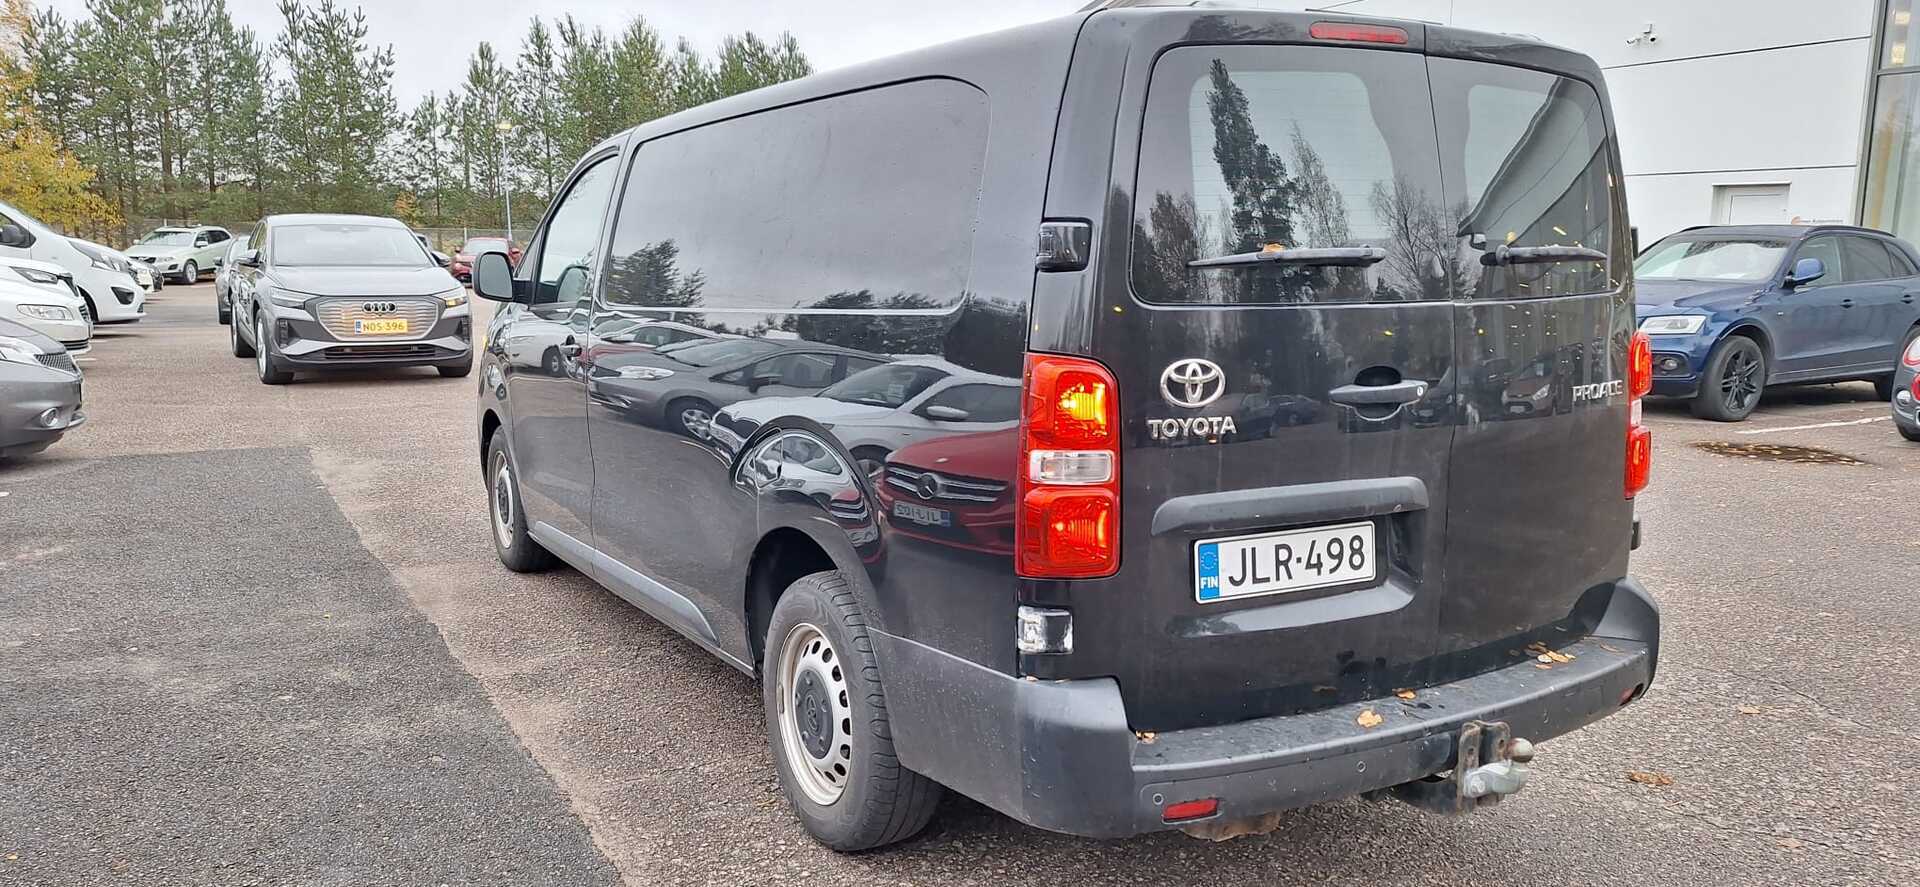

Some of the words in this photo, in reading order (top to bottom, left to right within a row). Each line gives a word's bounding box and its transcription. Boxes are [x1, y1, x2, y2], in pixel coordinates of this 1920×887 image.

[1572, 380, 1623, 402] PROACE
[1147, 416, 1236, 438] TOYOTA
[1229, 535, 1365, 586] JLR-498
[1200, 576, 1218, 588] FIN
